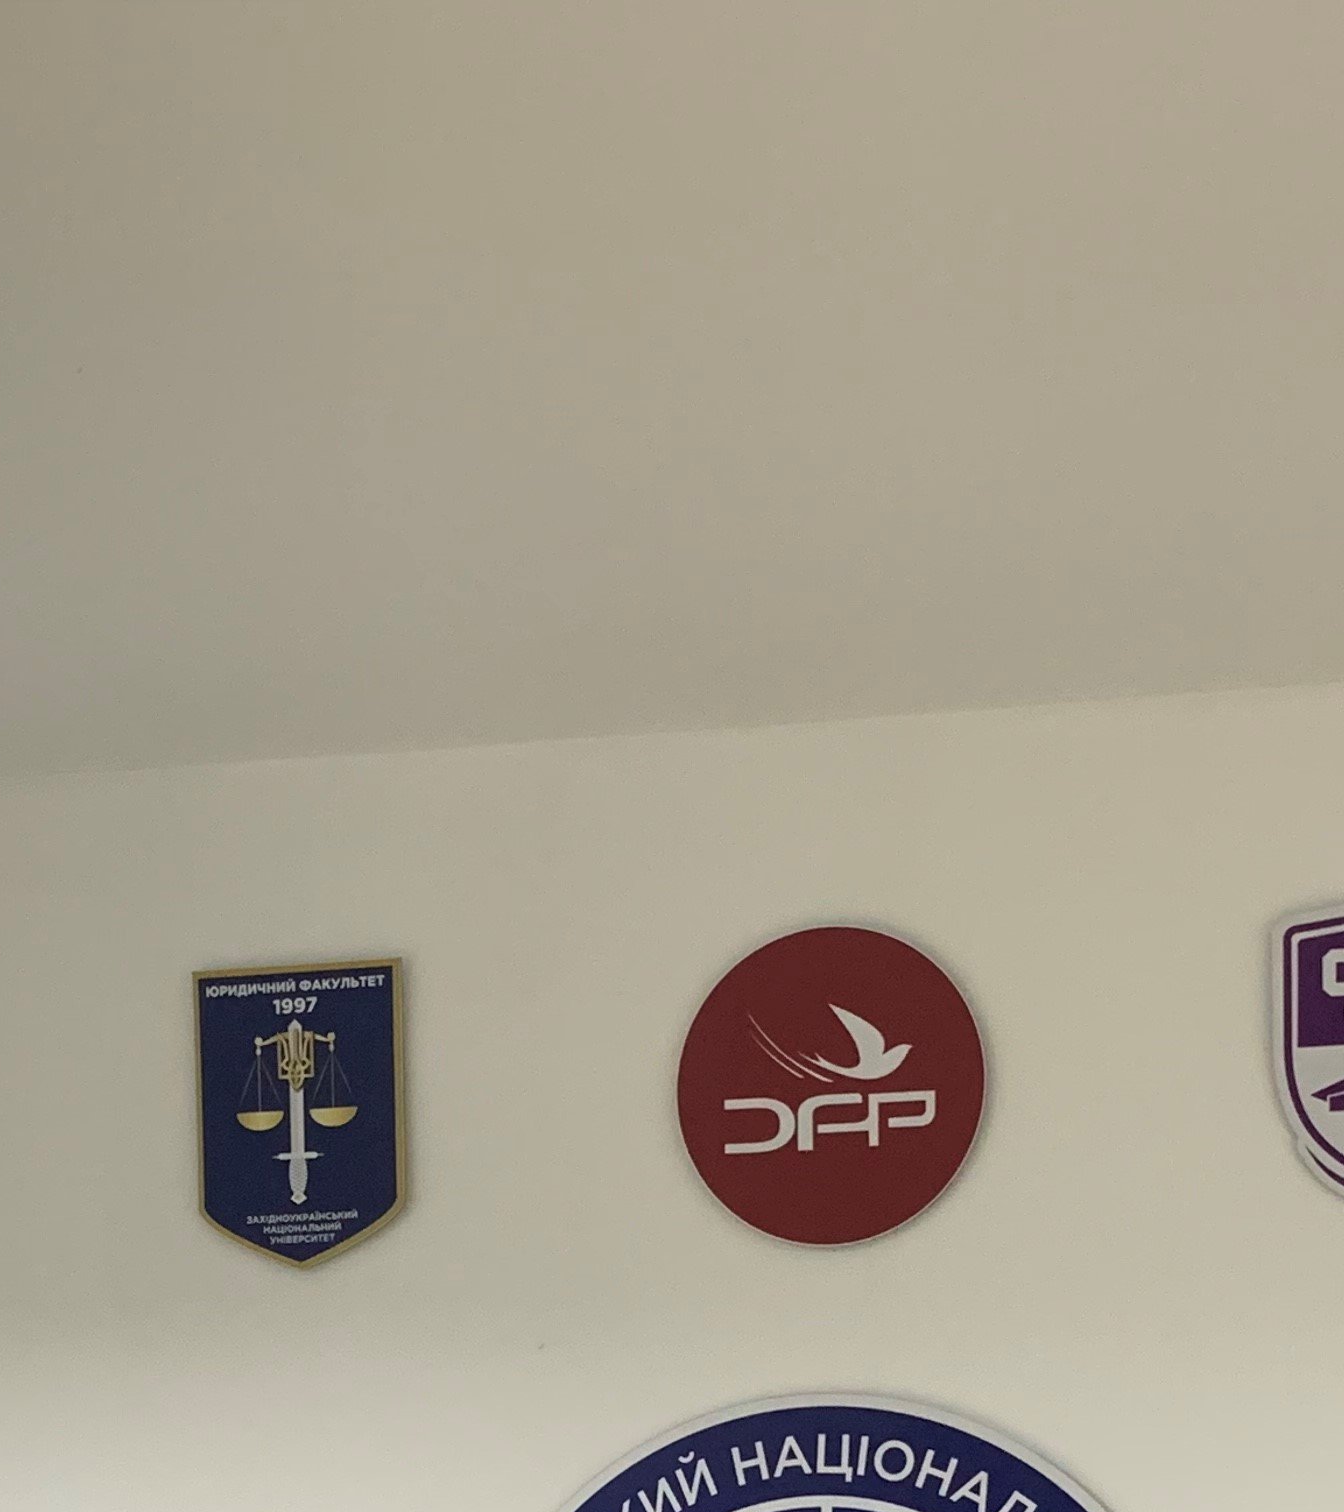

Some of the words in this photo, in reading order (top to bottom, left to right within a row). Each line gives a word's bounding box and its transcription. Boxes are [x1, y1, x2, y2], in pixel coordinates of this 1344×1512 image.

[205, 978, 296, 998] ЮРИДИЧНИЙ
[299, 974, 386, 992] ФАКУЛЬТЕТ
[272, 996, 318, 1015] 1997
[246, 1209, 359, 1225] ЗАХІДНОУКРАЇНСЬКИЙ
[263, 1221, 342, 1235] НАЦІОНАЛЬНИЙ
[269, 1233, 335, 1246] УНІВЕРСИТЕТ
